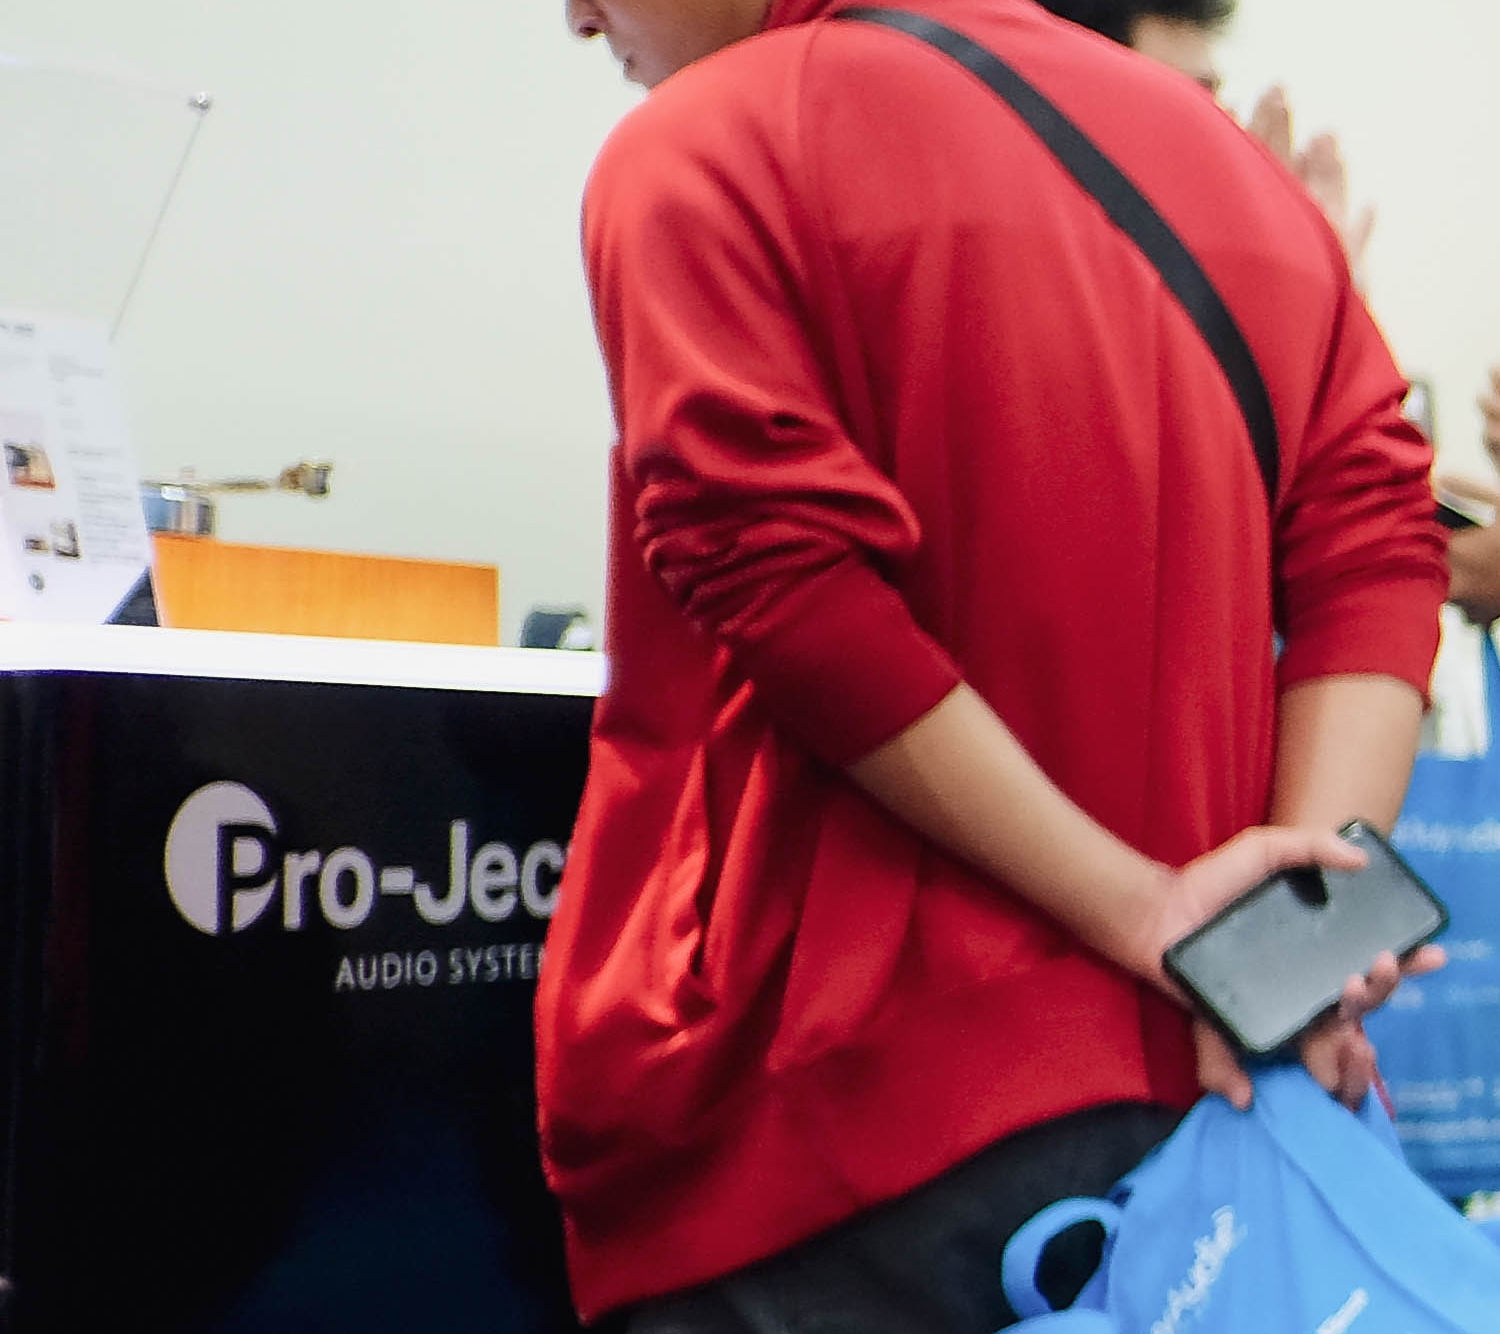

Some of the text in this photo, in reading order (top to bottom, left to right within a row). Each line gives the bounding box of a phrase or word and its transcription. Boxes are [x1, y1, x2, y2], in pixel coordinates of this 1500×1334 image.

[164, 780, 570, 936] Pro-Jec
[334, 944, 546, 993] AUDIO SYSTE
